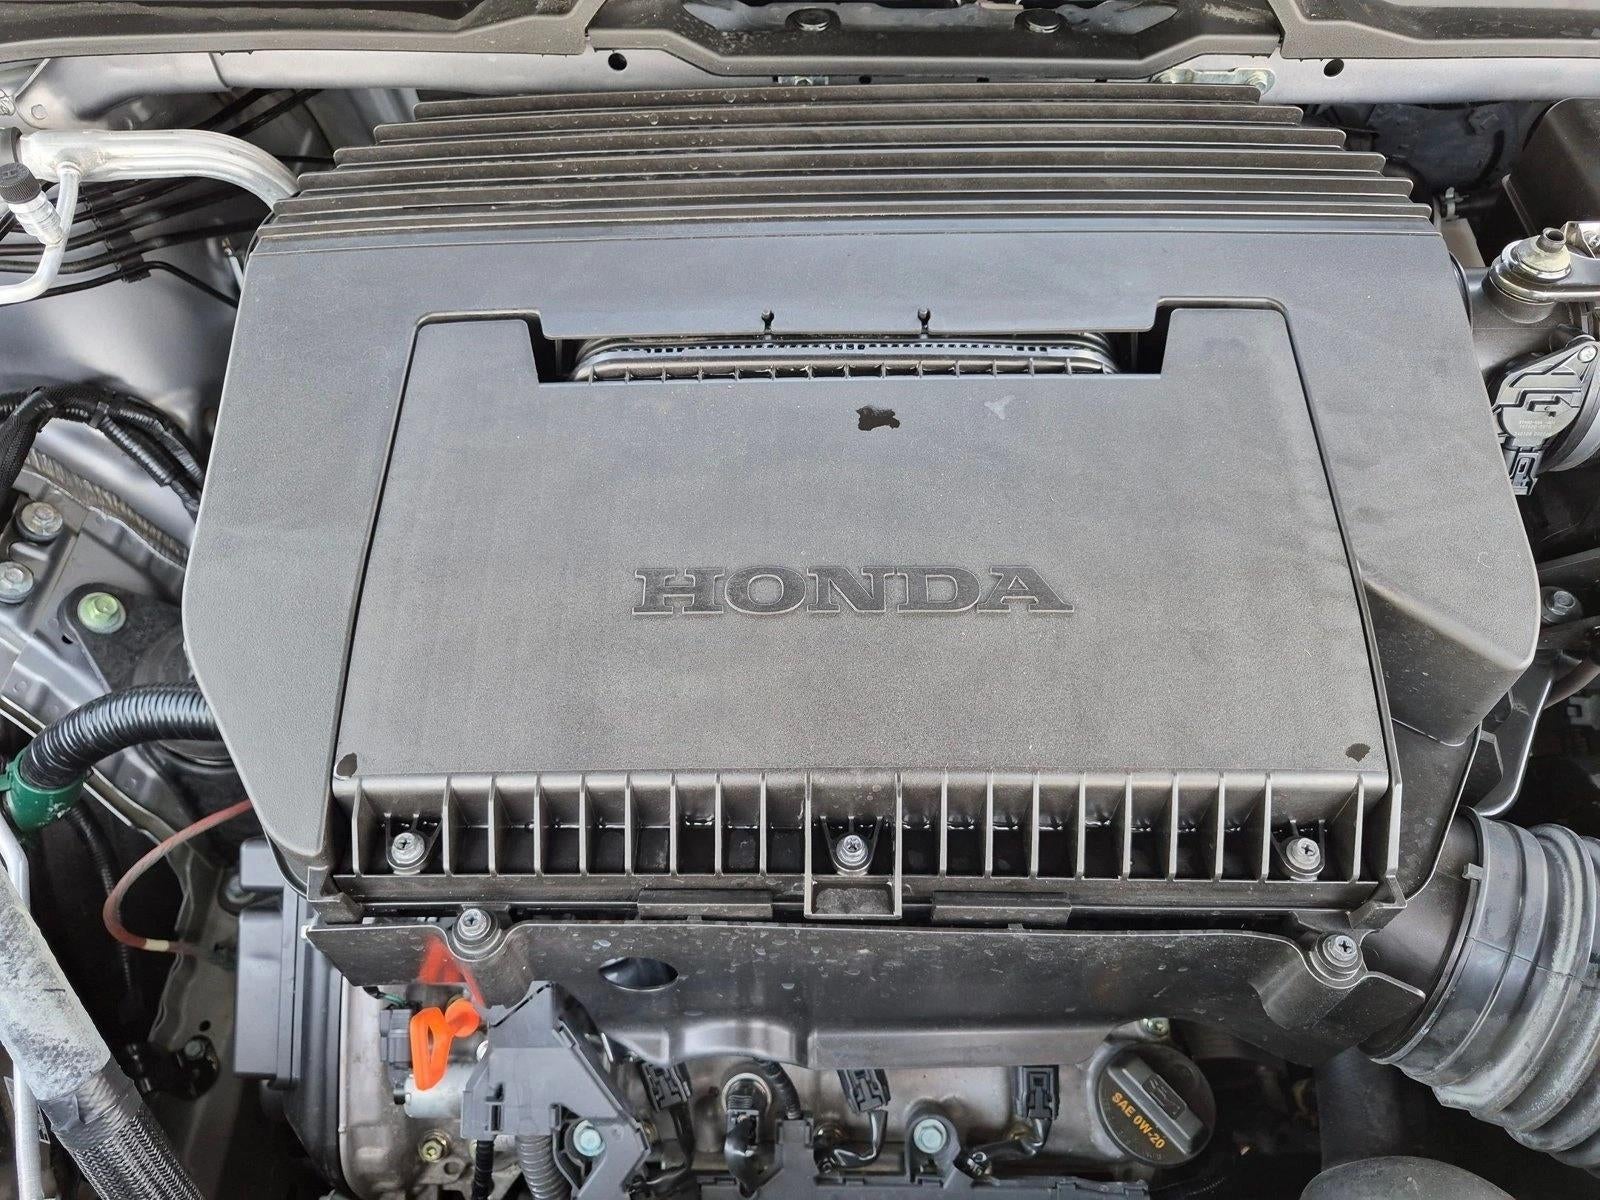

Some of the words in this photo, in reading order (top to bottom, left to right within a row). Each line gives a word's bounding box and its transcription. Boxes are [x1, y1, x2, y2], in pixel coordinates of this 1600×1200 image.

[632, 566, 1075, 614] HONDA
[1112, 1092, 1136, 1117] SAE
[1133, 1115, 1166, 1149] 0W-20
